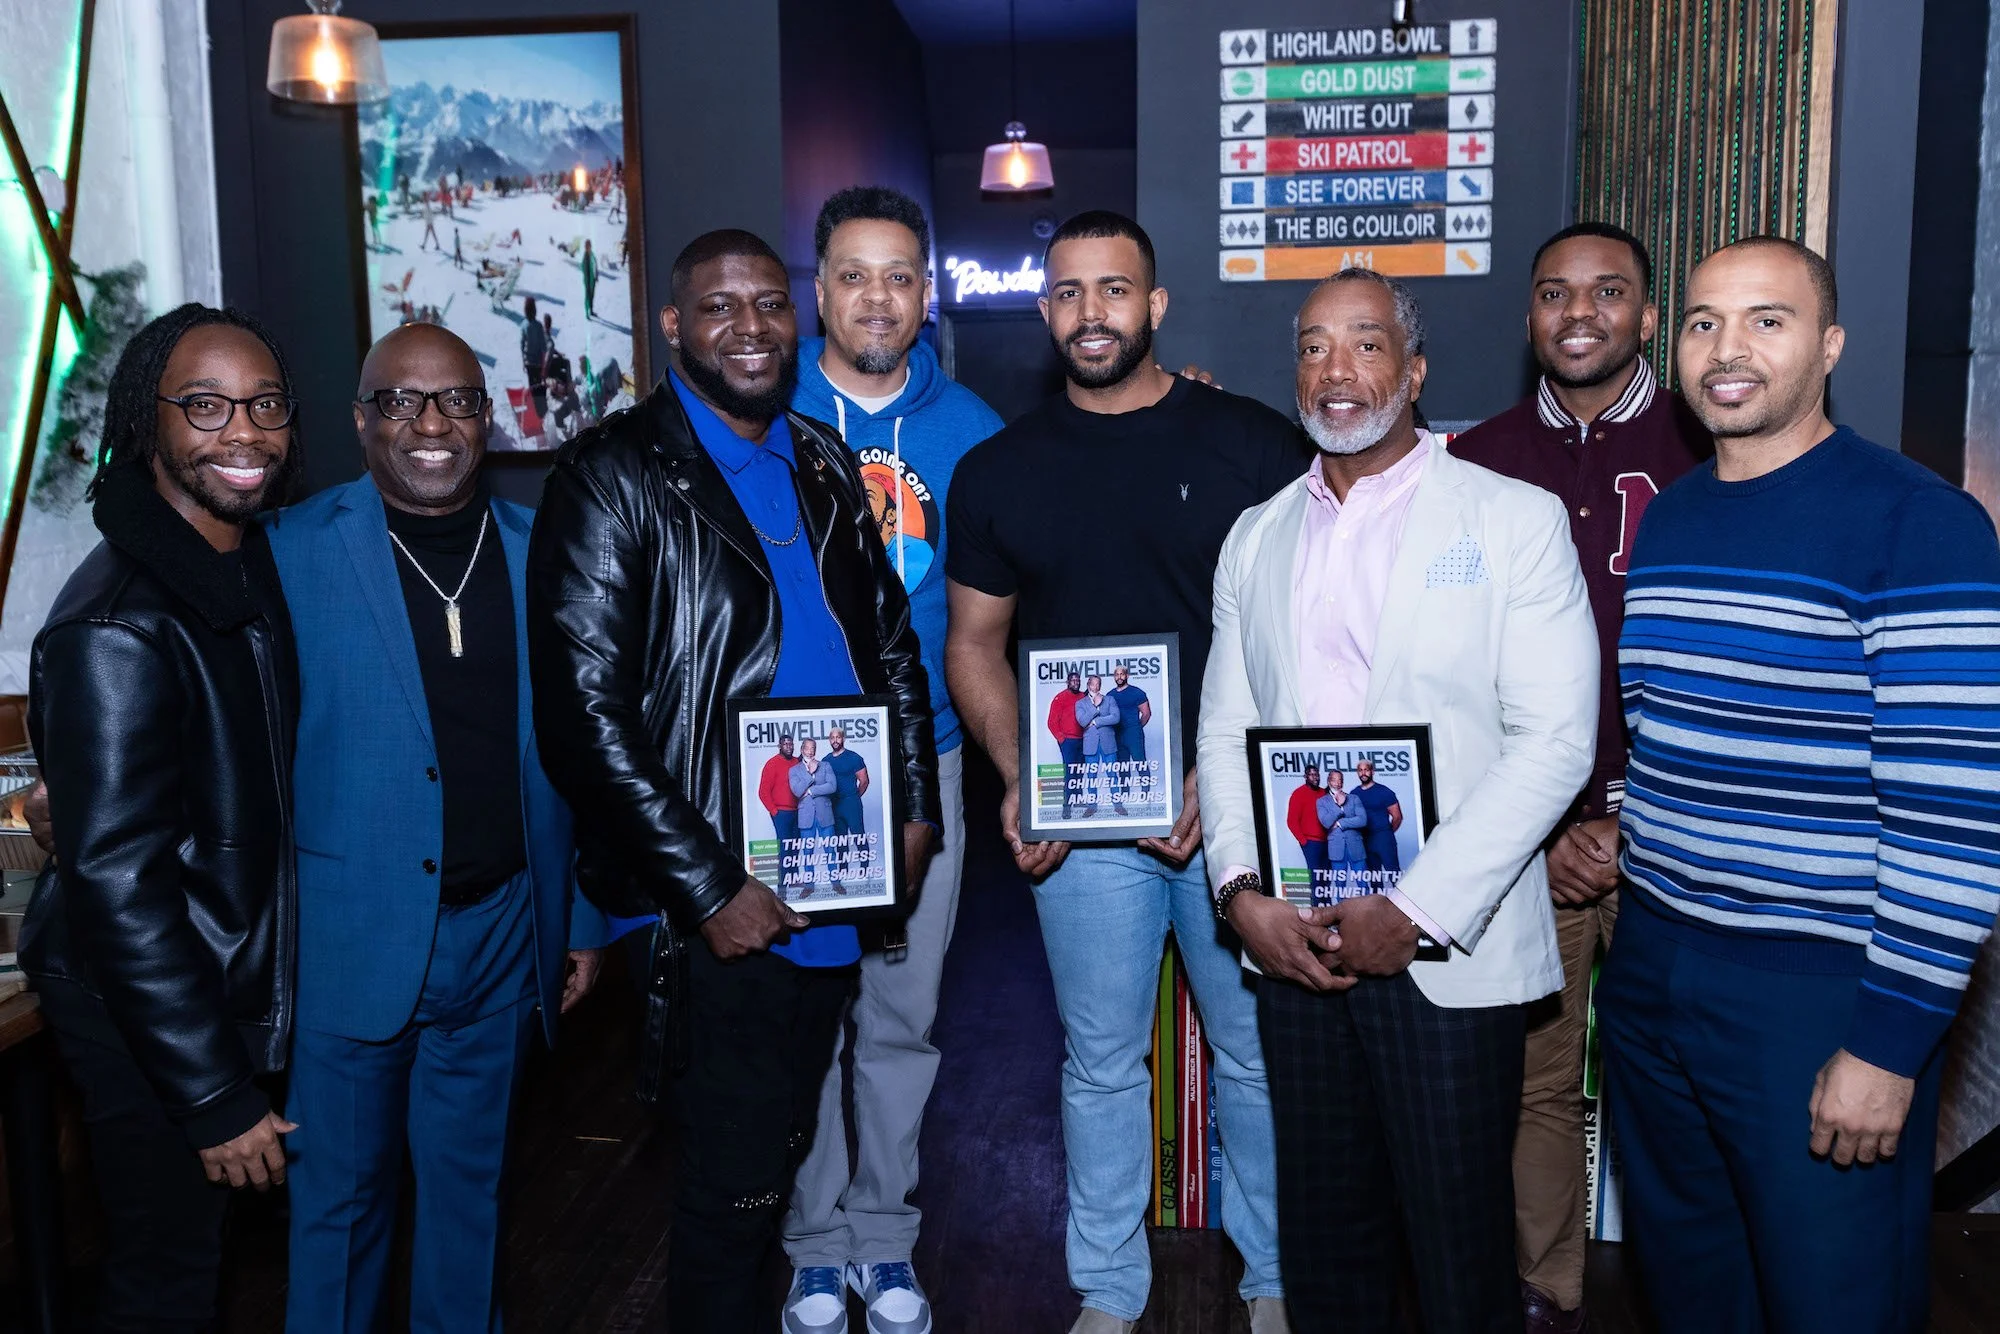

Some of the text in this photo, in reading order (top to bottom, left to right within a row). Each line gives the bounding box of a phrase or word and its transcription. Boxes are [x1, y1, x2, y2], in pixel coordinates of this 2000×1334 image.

[1273, 27, 1442, 58] HIGHLAND BOWL
[1301, 66, 1416, 94] GOLD DUST
[1303, 103, 1413, 130] WHITE OUT
[1298, 140, 1412, 168] SKI PATROL
[1285, 176, 1425, 204] SEE FOREVER
[1275, 213, 1436, 241] THE BIG COULOIR
[1340, 252, 1373, 269] A51
[1038, 656, 1161, 681] CHIWELLNESS
[746, 718, 879, 744] CHIWELLNESS
[1067, 763, 1098, 775] THIS
[1100, 760, 1160, 773] MONTH'S
[1271, 750, 1411, 773] CHIWELLNESS
[1067, 775, 1158, 790] CHIWELLNESS
[1067, 791, 1165, 805] AMBASSADORS
[782, 832, 878, 851] THIS MONTH'S
[782, 850, 877, 868] CHIWELLNESS
[783, 866, 884, 886] AMBASSADORS
[1312, 869, 1346, 882] THIS
